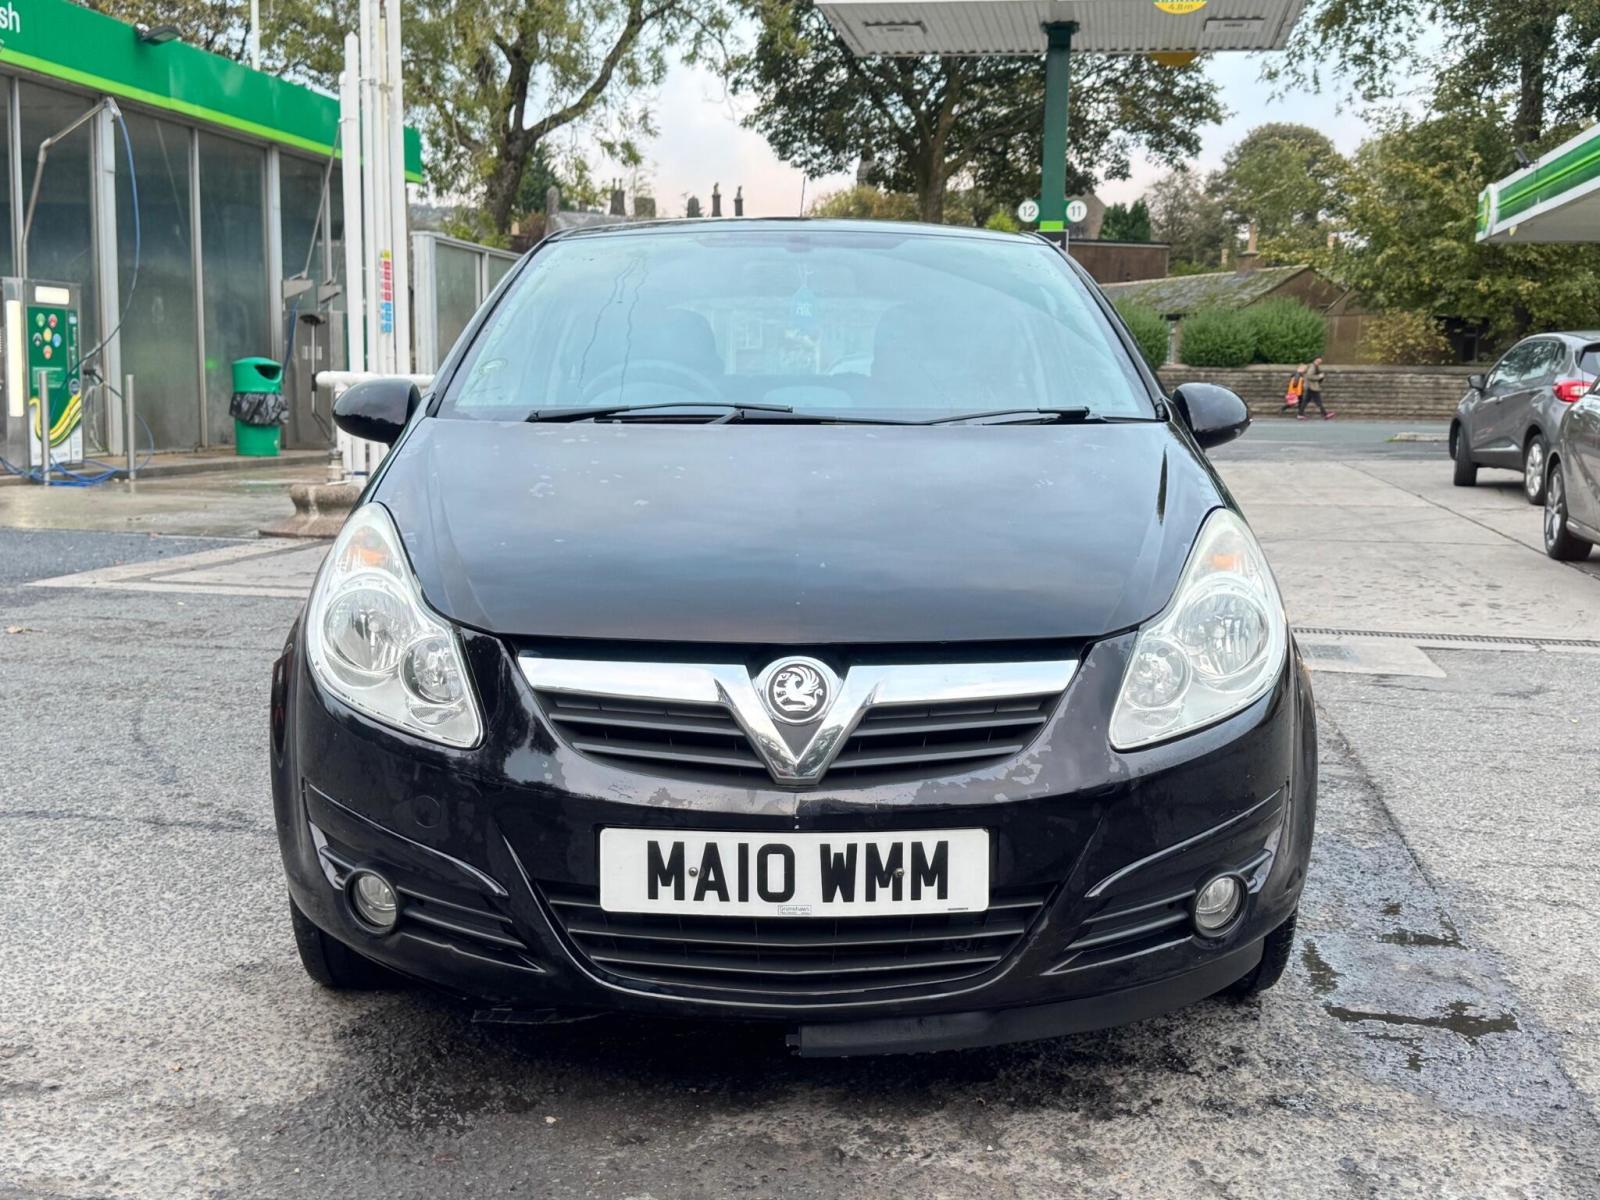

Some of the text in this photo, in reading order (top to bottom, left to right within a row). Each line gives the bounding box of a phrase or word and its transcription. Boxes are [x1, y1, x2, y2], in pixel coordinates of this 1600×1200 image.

[1022, 205, 1036, 217] 12
[1071, 205, 1082, 217] 11
[648, 841, 949, 903] MA10 WMM
